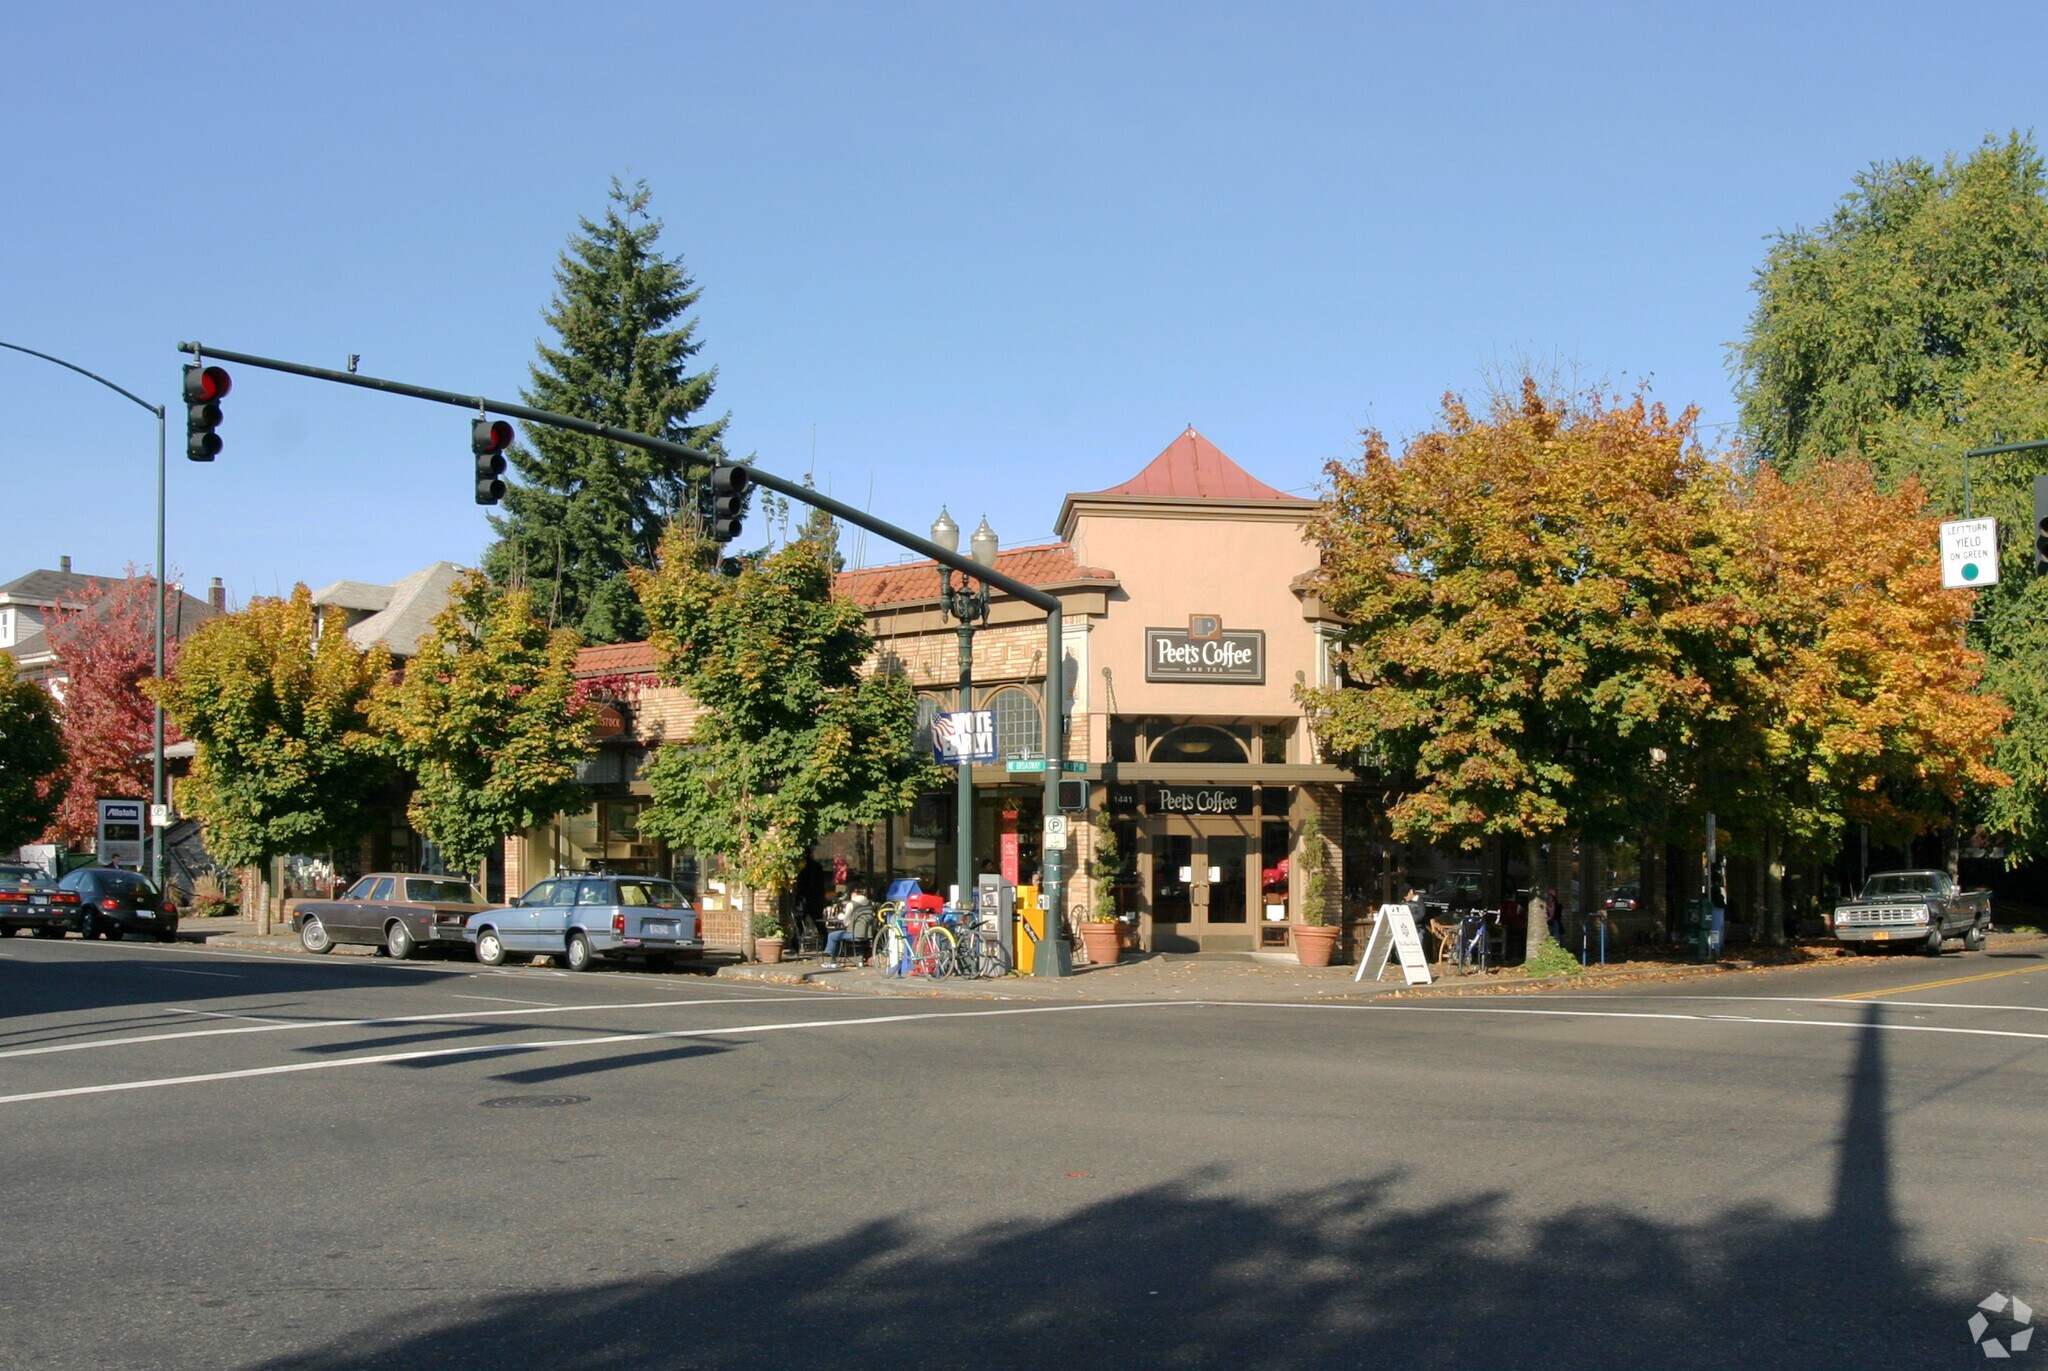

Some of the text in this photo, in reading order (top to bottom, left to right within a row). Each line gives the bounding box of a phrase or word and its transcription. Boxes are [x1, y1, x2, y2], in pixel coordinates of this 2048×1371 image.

[1947, 523, 1988, 536] LEFT TURN
[1955, 536, 1981, 548] YIELD
[1950, 550, 1988, 561] ON GREEN
[1156, 638, 1252, 668] Peet's Coffee
[951, 711, 993, 734] VOTE
[1114, 795, 1133, 804] 1441
[1158, 789, 1238, 814] Peet's Coffee
[107, 808, 137, 817] Allstate
